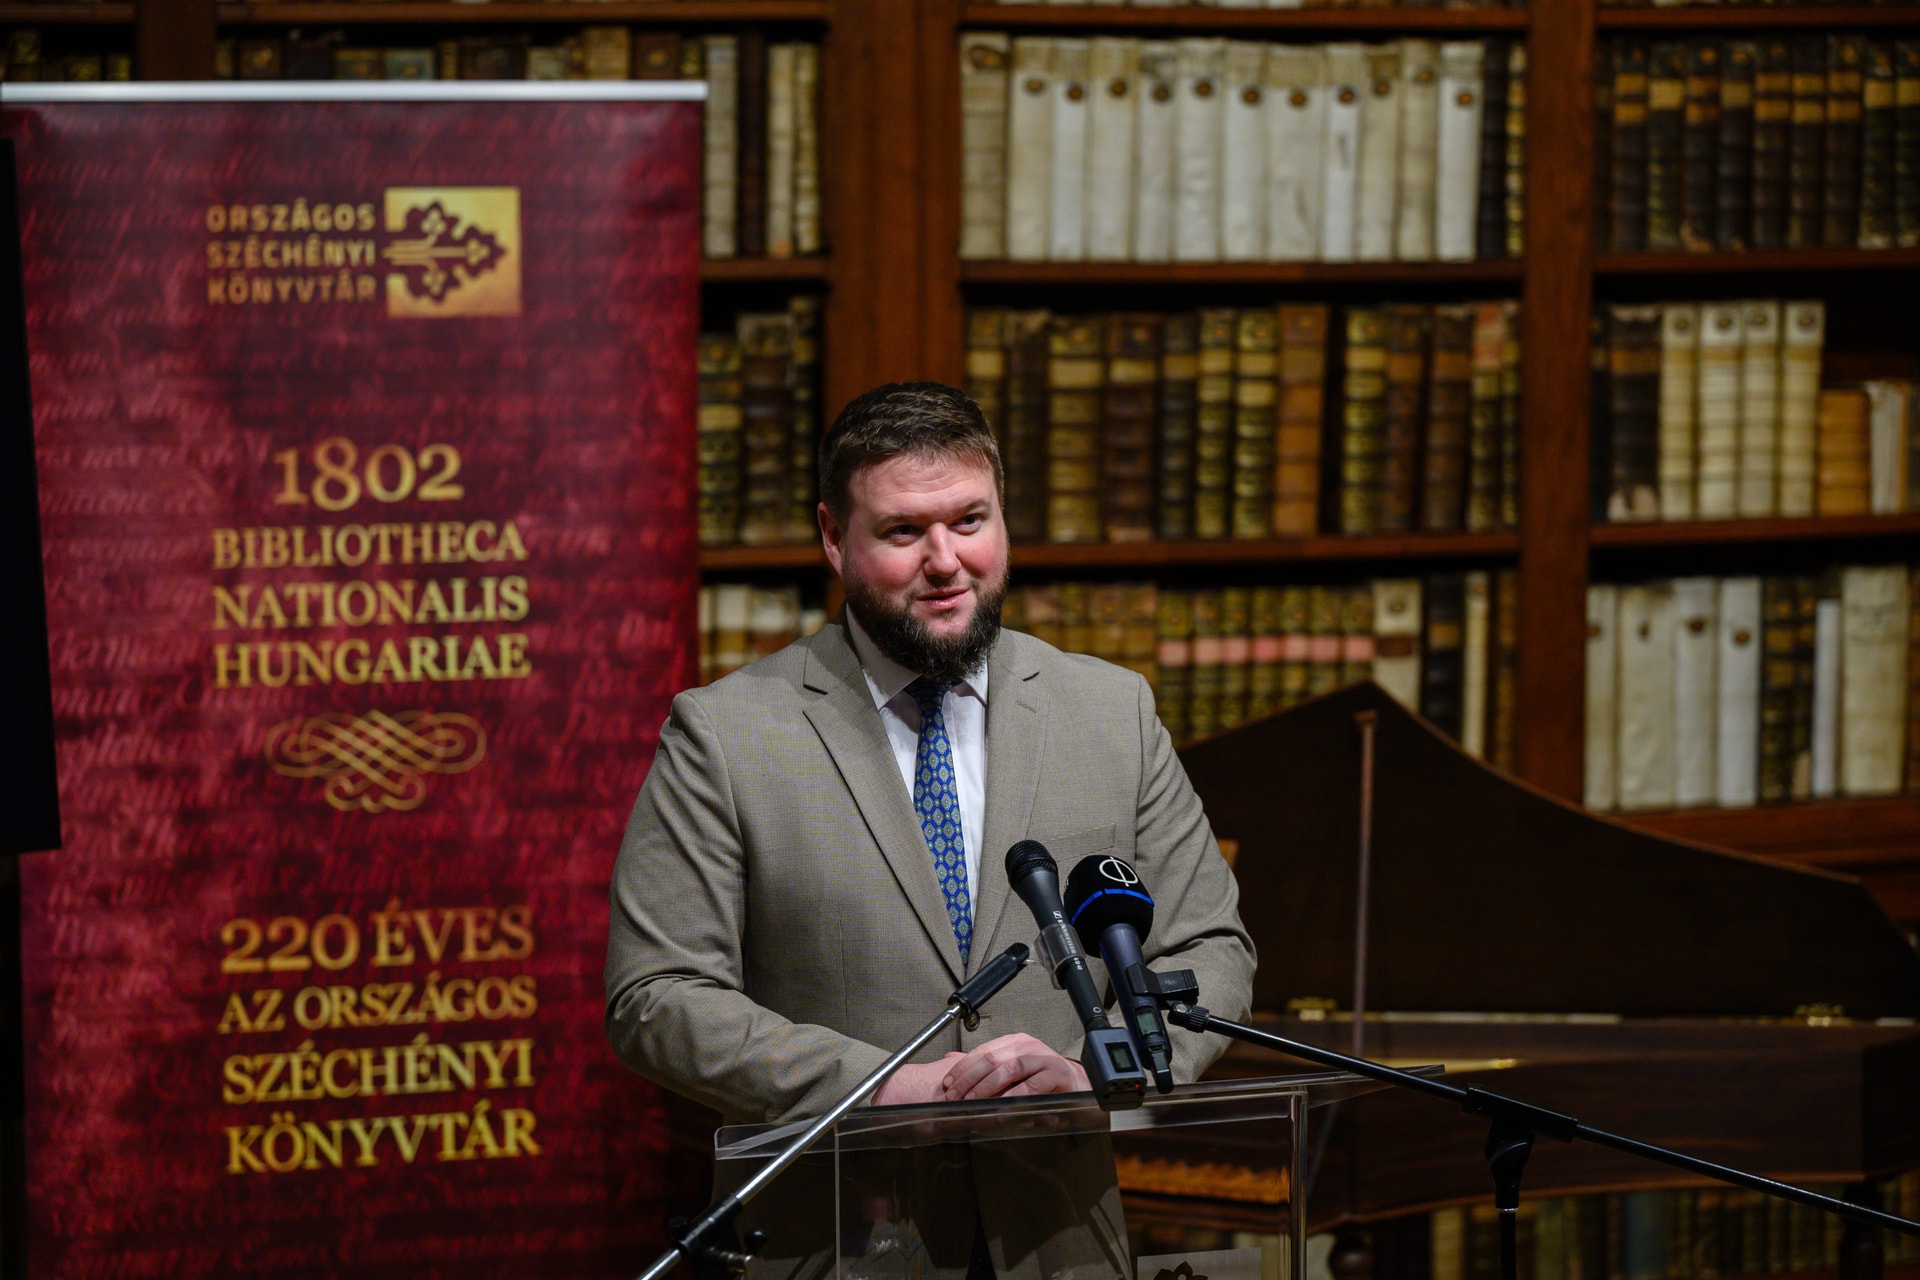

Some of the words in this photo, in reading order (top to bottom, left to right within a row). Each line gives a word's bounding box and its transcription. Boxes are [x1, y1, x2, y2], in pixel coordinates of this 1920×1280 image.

[206, 197, 376, 232] ORSZÁGOS
[207, 233, 376, 268] SZÉCHÉNYI
[207, 269, 377, 304] KÖNYVTÁR
[273, 437, 464, 511] 1802
[213, 520, 528, 569] BIBLIOTHECA
[212, 575, 530, 630] NATIONALIS
[213, 632, 532, 688] HUNGARIAE
[221, 913, 360, 974] 220
[371, 899, 534, 966] ÉVES
[218, 989, 285, 1034] AZ
[293, 970, 538, 1030] ORSZÁGOS
[223, 1033, 535, 1104] SZÉCHÉNYI
[225, 1098, 542, 1175] KÖNYVTÁR
